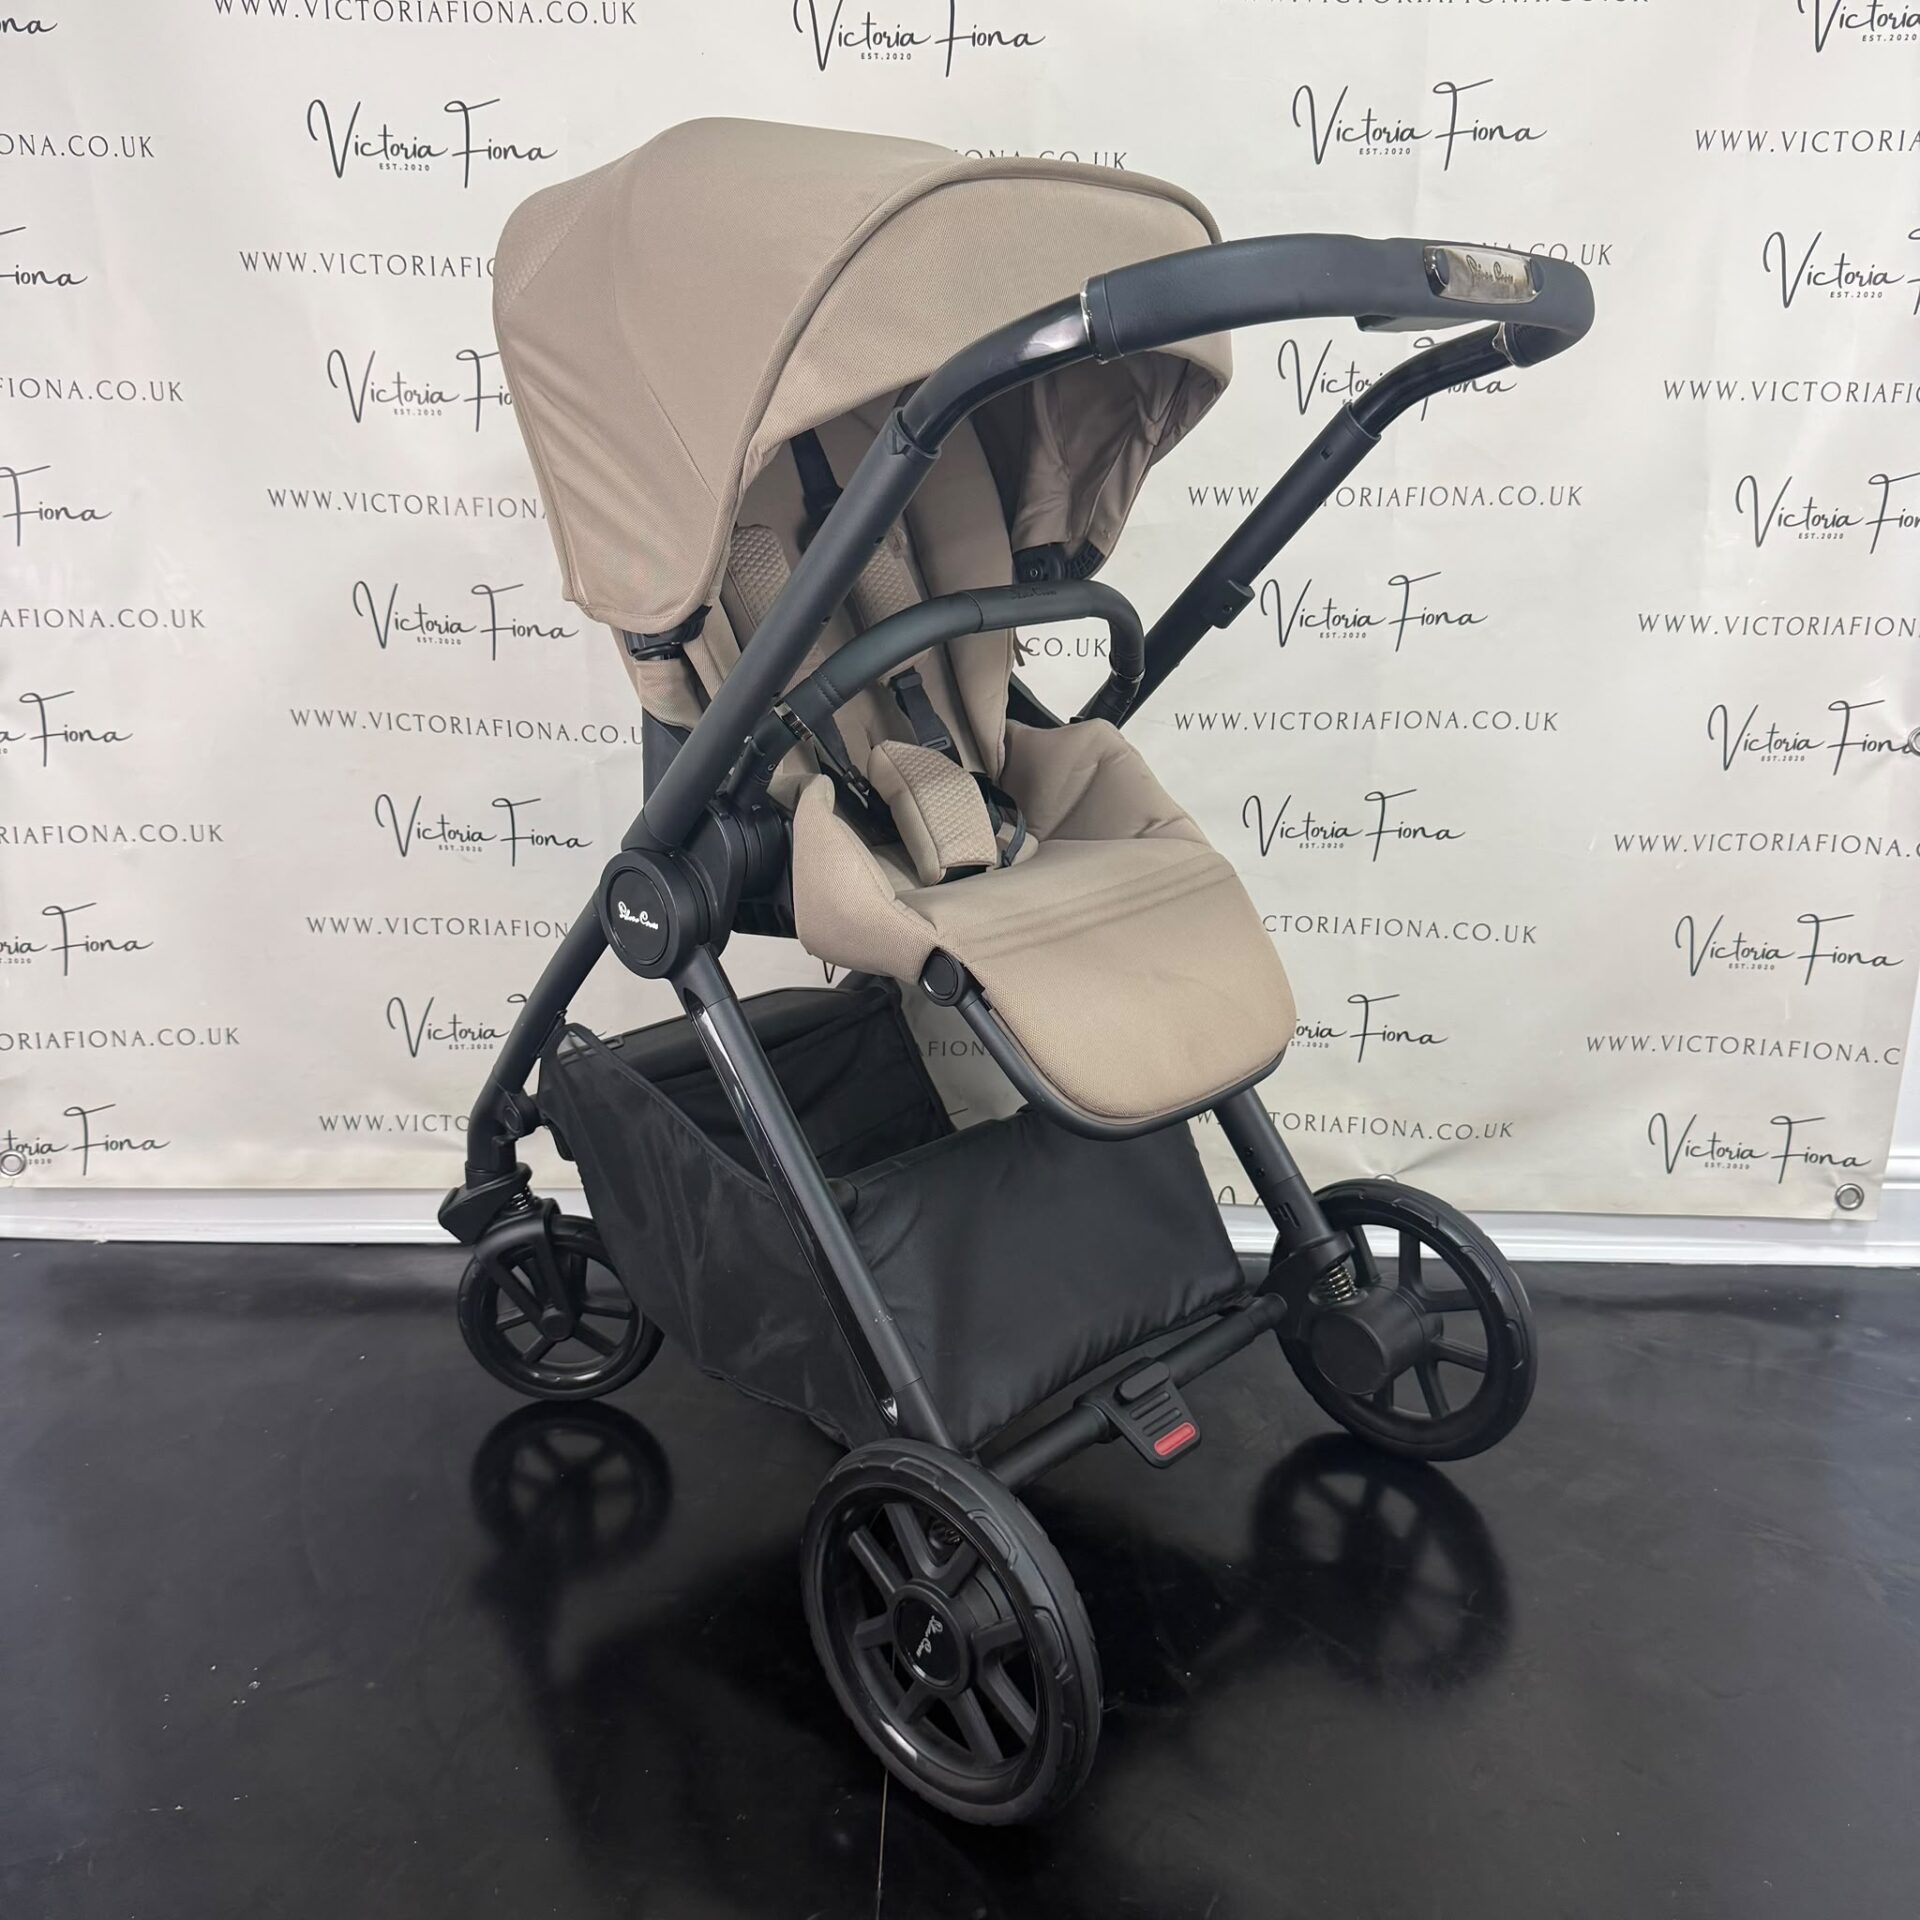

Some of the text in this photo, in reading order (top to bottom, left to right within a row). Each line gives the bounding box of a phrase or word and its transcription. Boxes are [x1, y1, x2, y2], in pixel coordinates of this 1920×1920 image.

[215, 0, 637, 24] WWW.VICTORIAFIONA.CO.UK
[1861, 32, 1918, 43] EST.2020
[860, 51, 912, 61] EST.2020
[1292, 79, 1547, 171] Victoria Fiona
[307, 98, 558, 189] Victoria Fiona
[1358, 147, 1411, 156] EST.2020
[1696, 130, 1920, 153] WWW.VICTORIA
[378, 162, 431, 172] EST.2020
[239, 251, 496, 278] WWW.VICTORIAFI
[1763, 232, 1905, 309] Victoria
[1829, 290, 1883, 299] EST.2020
[327, 349, 512, 432] Victoria Fio
[1278, 339, 1371, 415] Victo
[1664, 380, 1920, 403] WWW.VICTORIAFI
[0, 465, 112, 547] Fiona
[267, 489, 545, 519] WWW.VICTORIAFION
[1187, 484, 1583, 509] WWWORIAFIONA.CO.UK
[1735, 472, 1920, 554] Victoria Fio
[0, 609, 205, 628] AFIONA.CO.UK
[353, 581, 579, 661] Victoria Fiona
[1260, 571, 1488, 652] Victoria Fiona
[1638, 613, 1916, 637] WWW.VICTORIAFION
[19, 691, 133, 767] Fiona
[290, 709, 642, 744] WWW.VICTORIAFIONA.CO.U
[1175, 710, 1558, 731] WWW.VICTORIAFIONA.CO.UK
[1707, 704, 1825, 771] Victoria
[0, 824, 223, 844] RIAFIONA.CO.UK
[375, 794, 592, 867] Victoria Fiona
[1242, 789, 1466, 862] Victoria Fiona
[1614, 833, 1920, 857] WWW.VICTORIAFIONA.
[42, 902, 154, 976] Fiona
[306, 917, 567, 938] WWW.VICTORIAFION
[1263, 915, 1536, 944] CTORIAFIONA.CO.UK
[1675, 914, 1904, 986] Victoria Fiona
[0, 1028, 240, 1051] ORIAFIONA.CO.UK
[386, 997, 509, 1058] Victoria
[1296, 994, 1448, 1063] oria Fiona
[1587, 1035, 1900, 1065] WWW.VICTORIAFIONA.C
[0, 1104, 170, 1176] toria Fiona
[1648, 1113, 1872, 1188] Victoria Fiona
